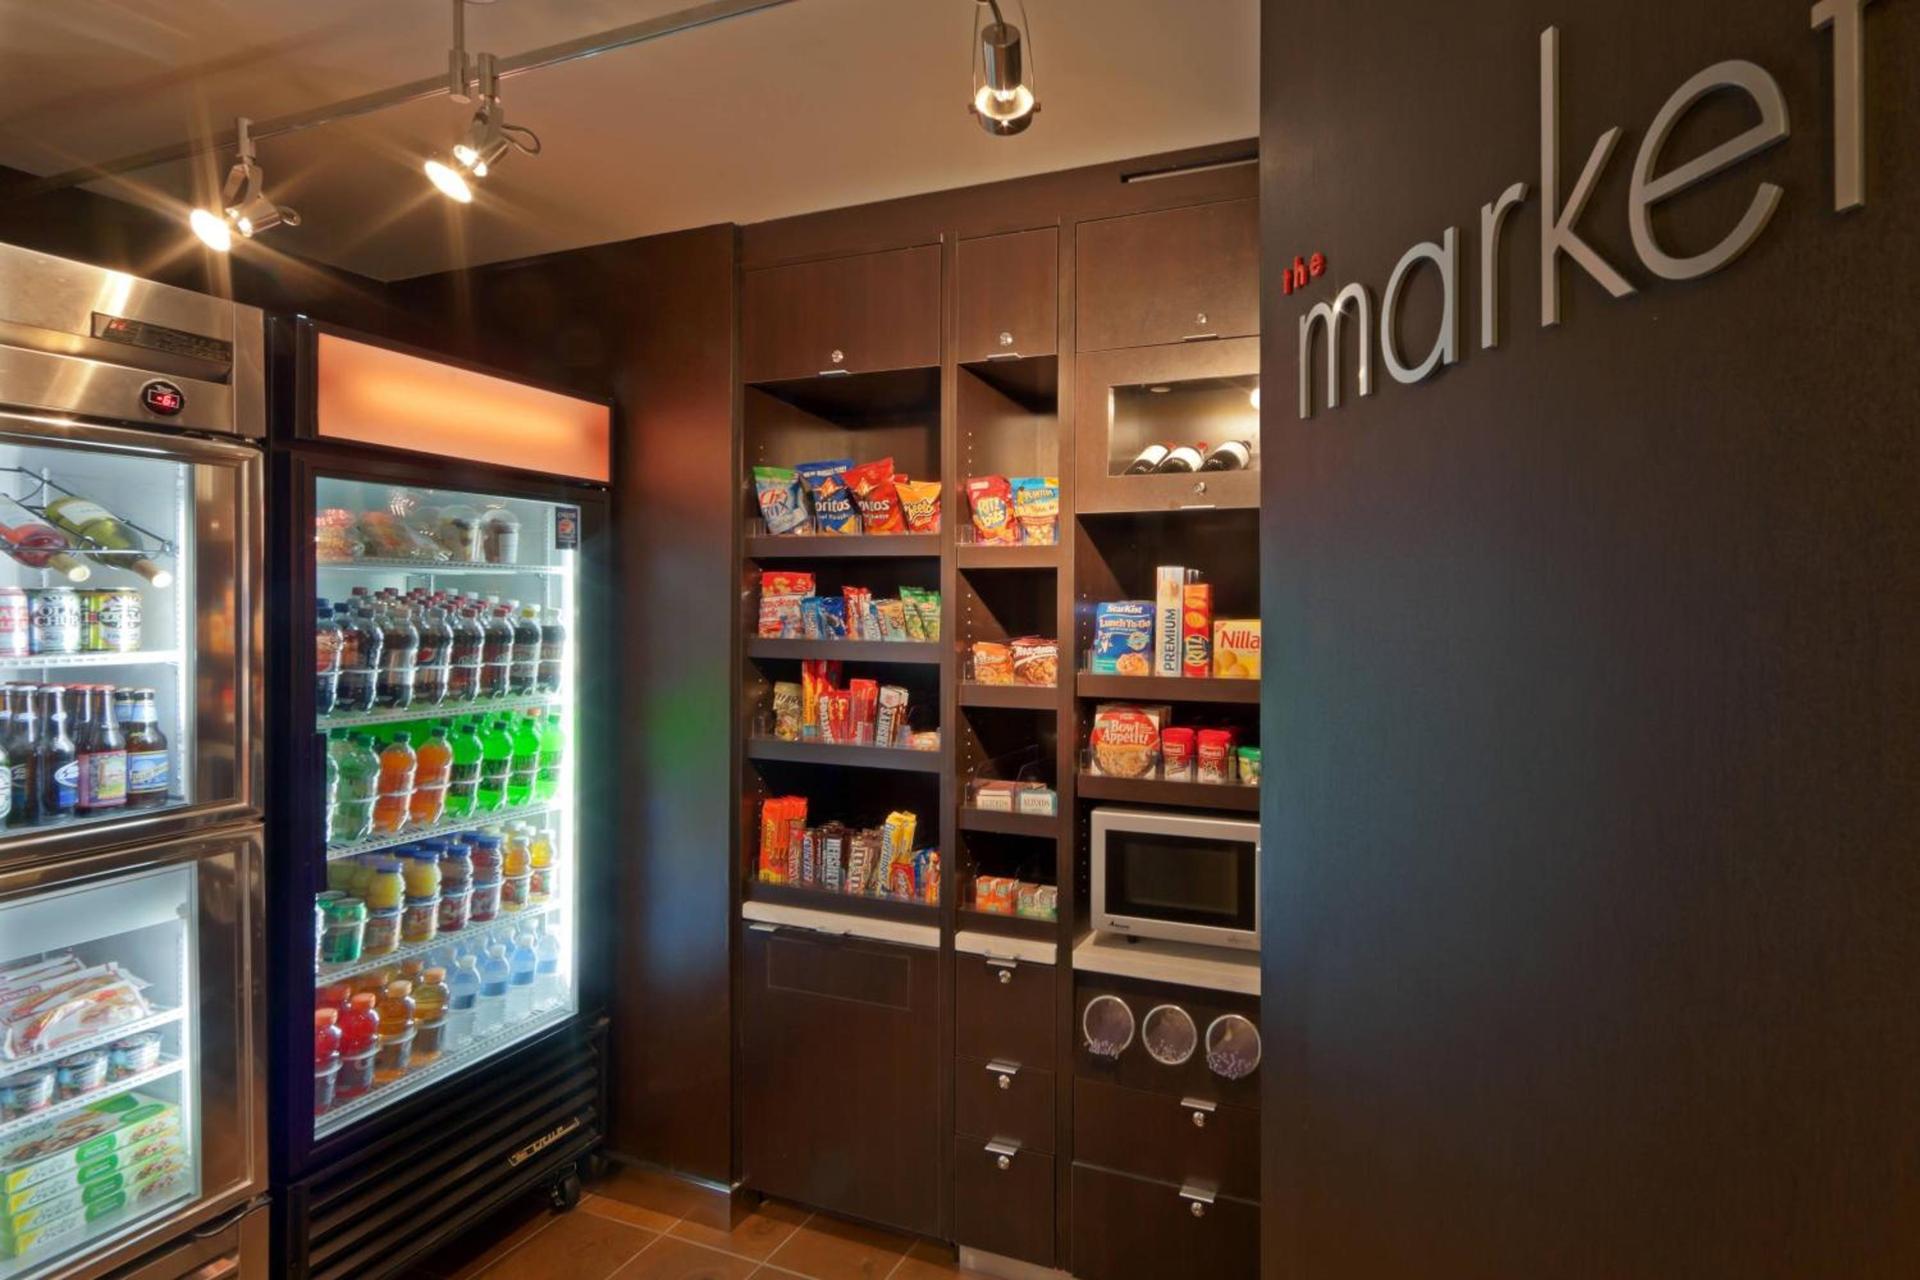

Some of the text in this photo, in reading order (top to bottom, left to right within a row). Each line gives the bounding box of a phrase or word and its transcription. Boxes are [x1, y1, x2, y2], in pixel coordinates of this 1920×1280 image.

[1299, 0, 1865, 420] market
[1283, 252, 1326, 296] the
[815, 498, 851, 513] oritos
[1164, 608, 1177, 672] PREMIUM
[1220, 629, 1260, 650] Nilla
